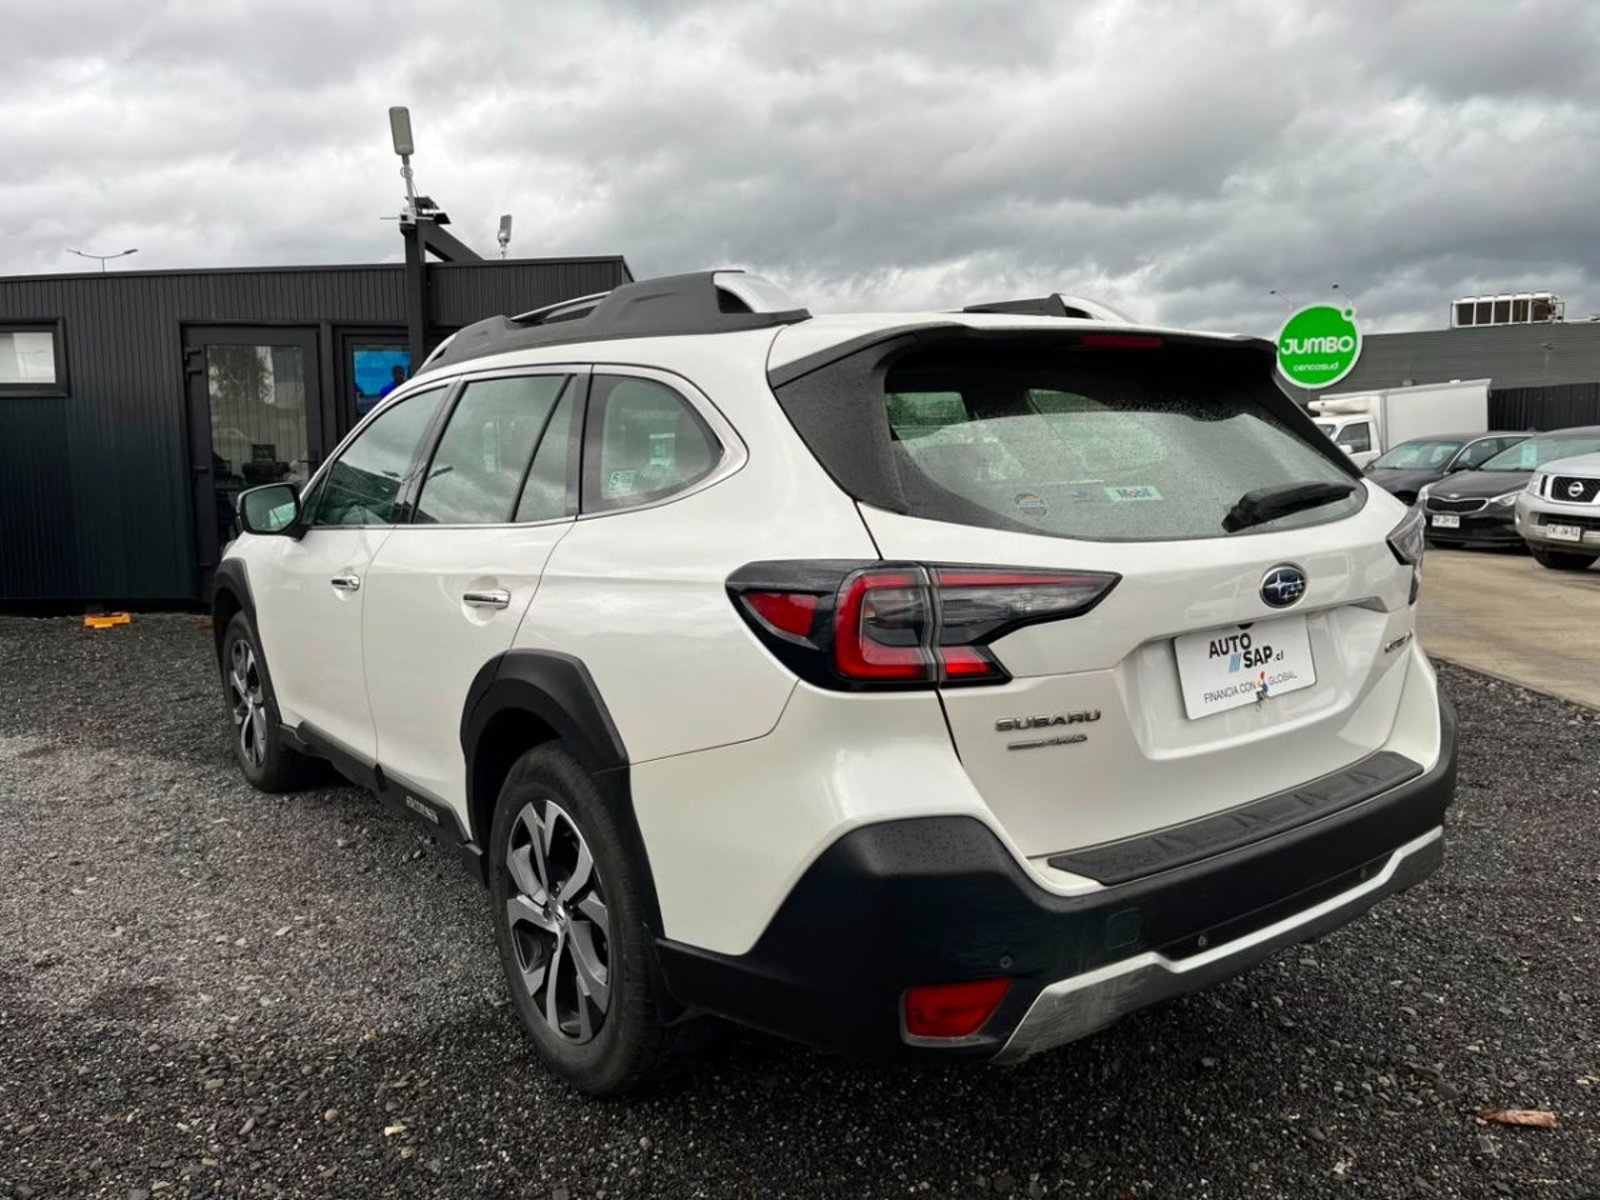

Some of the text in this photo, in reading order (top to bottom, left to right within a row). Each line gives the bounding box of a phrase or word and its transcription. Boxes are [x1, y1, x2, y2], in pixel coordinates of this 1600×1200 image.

[1281, 335, 1354, 355] JUMBO
[1208, 632, 1252, 659] AUTO
[1204, 671, 1298, 704] FINANCIA CON GLOBAL
[995, 708, 1101, 732] SUBARU
